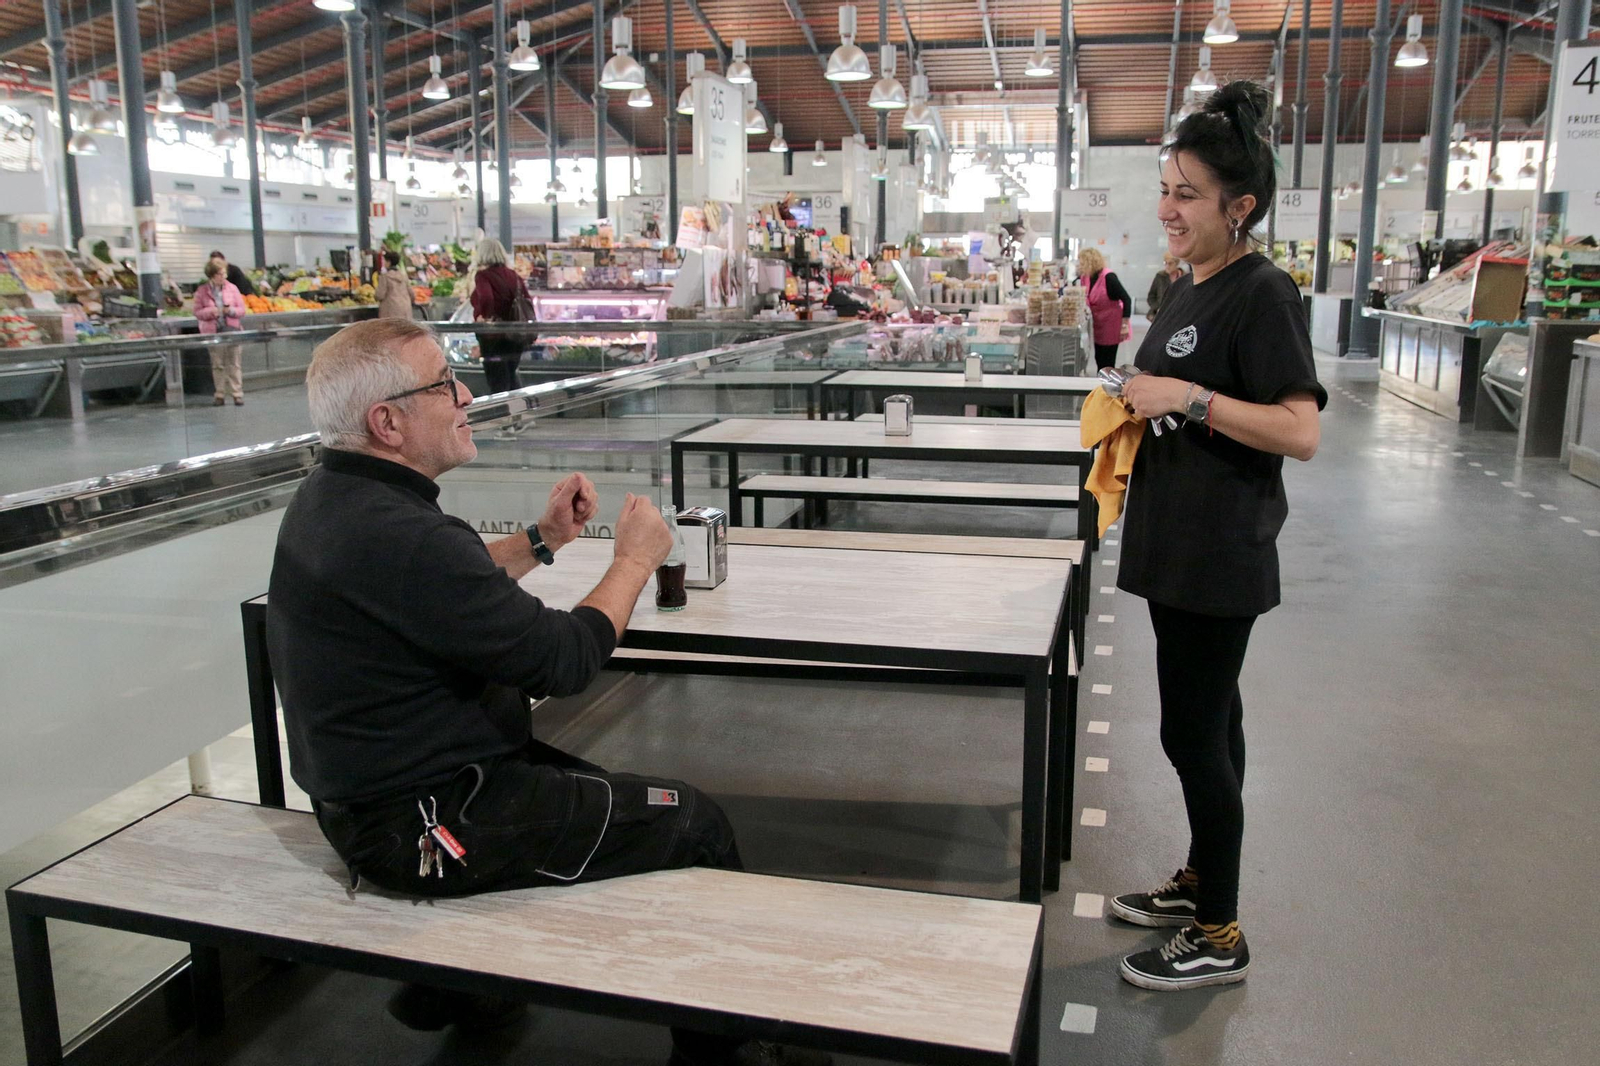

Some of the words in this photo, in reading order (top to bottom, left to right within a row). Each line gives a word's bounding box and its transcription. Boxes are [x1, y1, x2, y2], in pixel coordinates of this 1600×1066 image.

[711, 87, 725, 121] 35
[815, 195, 833, 209] 36
[1089, 193, 1108, 208] 38
[1281, 193, 1302, 208] 48
[413, 204, 429, 218] 30
